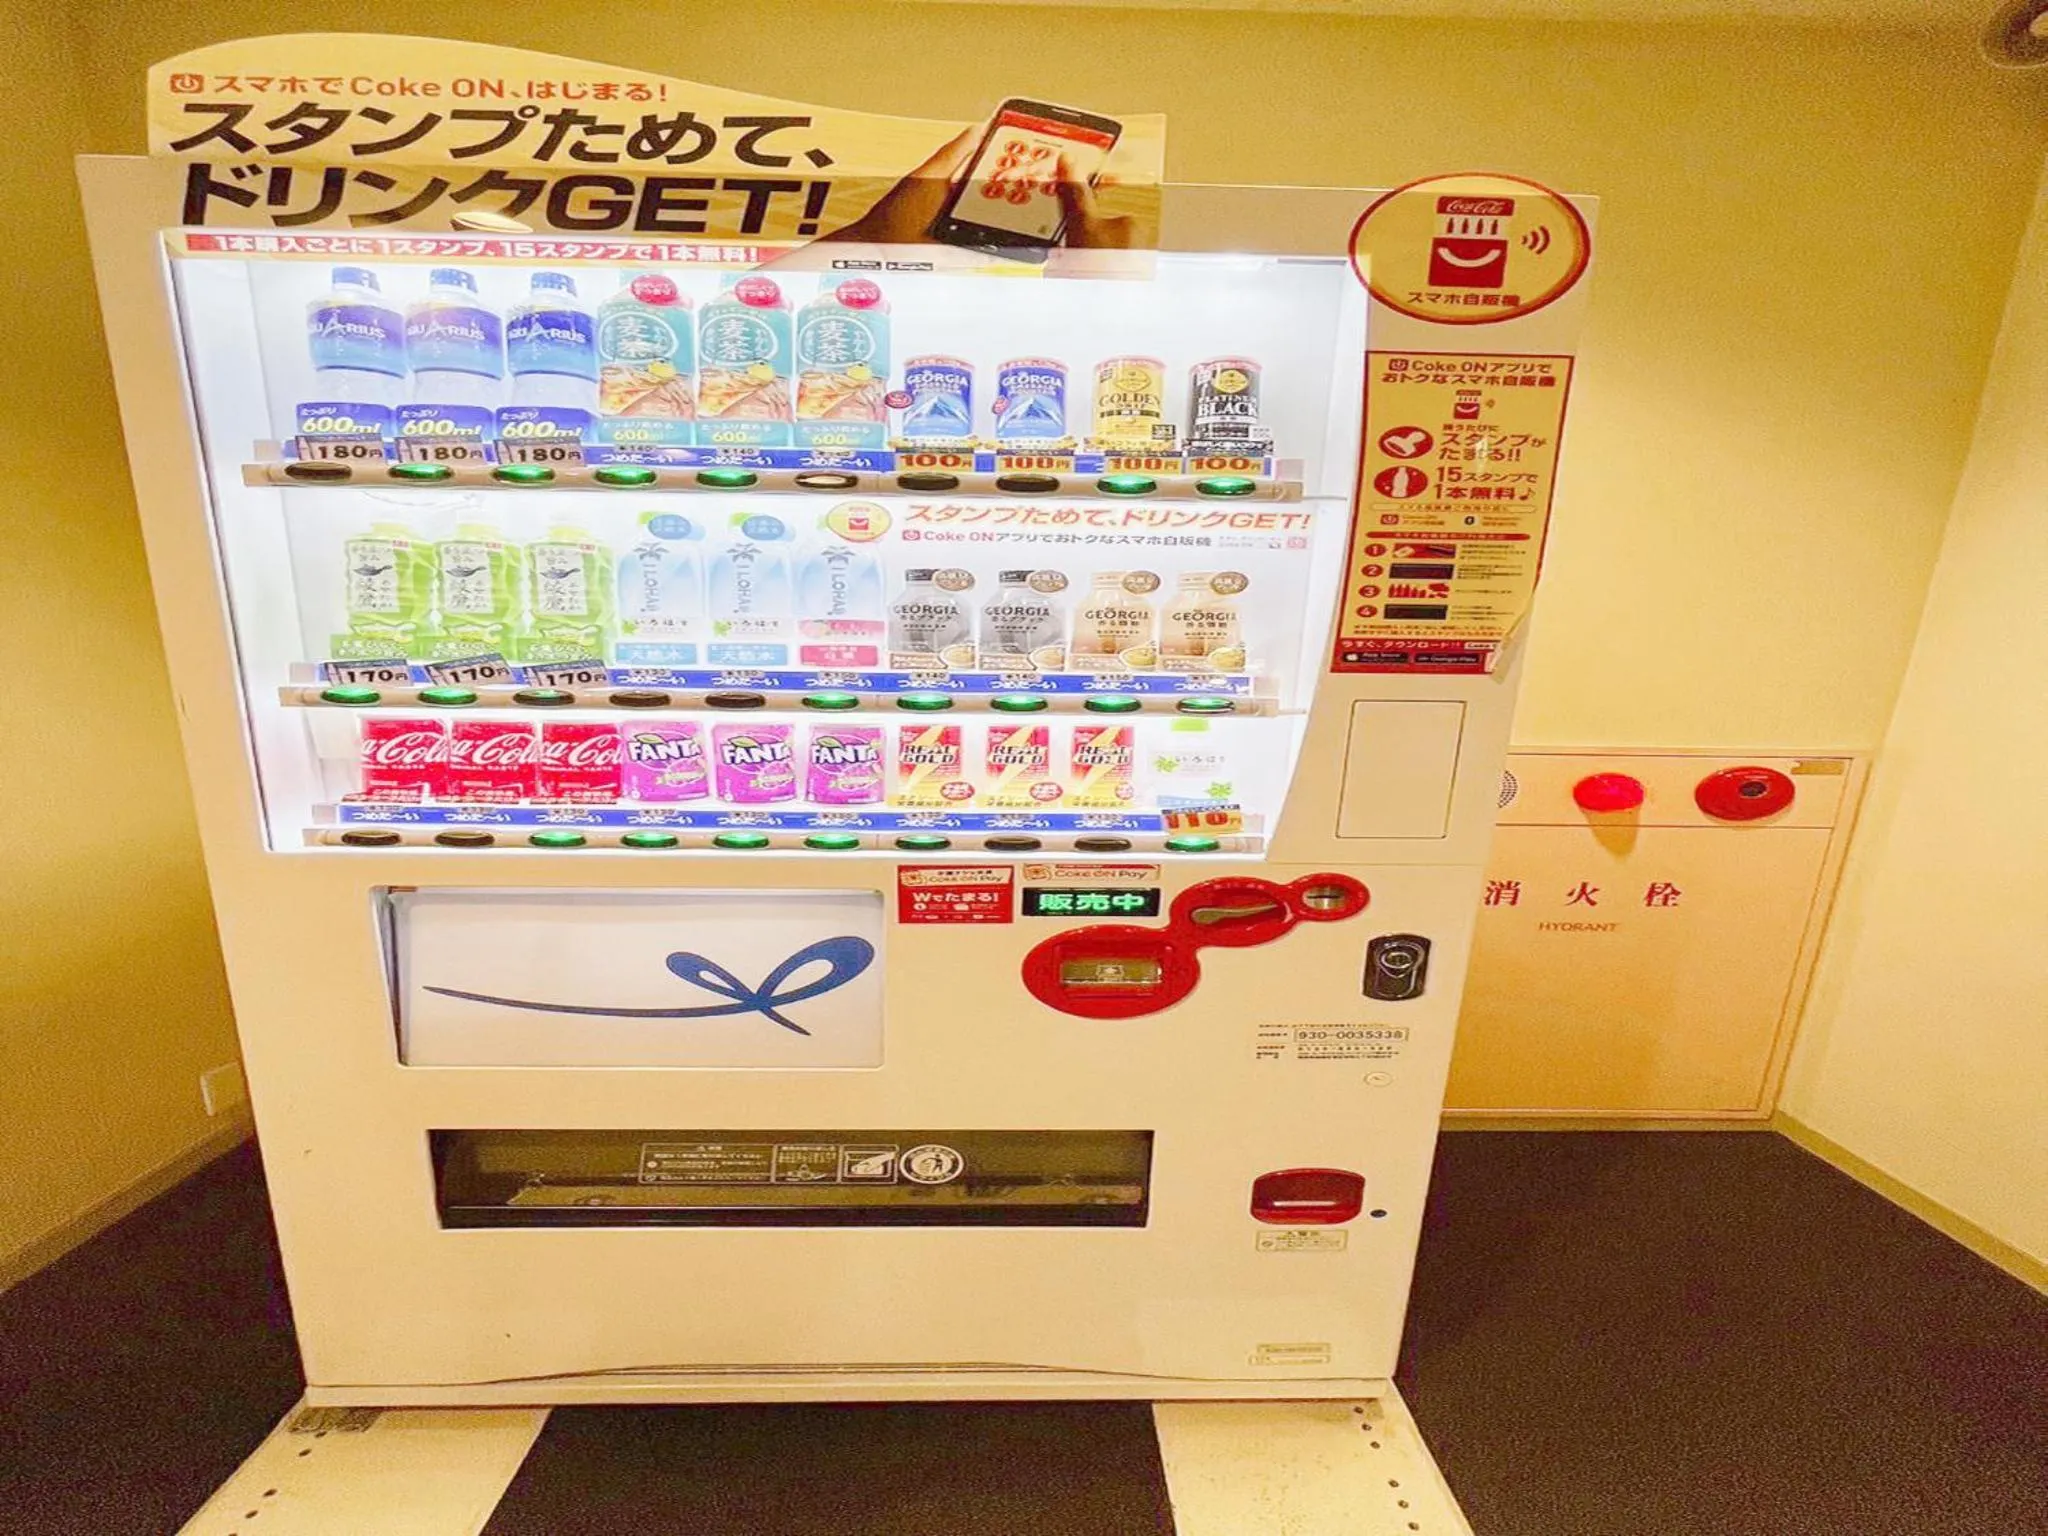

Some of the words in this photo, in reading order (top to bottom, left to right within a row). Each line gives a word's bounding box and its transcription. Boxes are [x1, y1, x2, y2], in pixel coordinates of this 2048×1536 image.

[169, 101, 836, 169] スタンプためて、
[182, 162, 832, 236] ドリンクGET!
[1406, 290, 1521, 308] スマホ自販機
[1411, 359, 1457, 373] Coke
[906, 370, 969, 386] GEORGIA
[1001, 371, 1063, 388] GEORGIA
[1381, 372, 1557, 388] おトクなスマホ自販機
[1197, 402, 1259, 416] BLACK
[302, 417, 382, 434] 600ml
[402, 419, 483, 436] 600ml
[502, 421, 584, 438] 600ml
[317, 445, 383, 459] 180円
[418, 446, 483, 460] 180円
[516, 447, 582, 462] 180円
[900, 454, 972, 468] 100円
[1002, 455, 1071, 469] 100円
[1109, 457, 1180, 471] 100円
[1194, 456, 1262, 471] 100円
[905, 504, 1311, 529] スタンプためて、ドリンクGET!
[923, 530, 966, 542] Coke
[895, 603, 960, 615] GEORGIA
[985, 605, 1050, 617] GEORGIA
[1085, 607, 1150, 620] GEORGIA
[1172, 609, 1237, 622] GEORGIA
[346, 669, 409, 683] 170円
[449, 664, 510, 684] 170円
[545, 670, 607, 687] 170円
[626, 738, 702, 762] FANTA
[720, 742, 792, 765] FANTA
[811, 742, 878, 765] FANTA
[1164, 811, 1242, 829] 110円
[1039, 893, 1146, 911] 販売中
[1484, 880, 1682, 908] 消火栓
[1538, 922, 1619, 932] HYDRANT
[1298, 1031, 1403, 1040] 930-0035338
